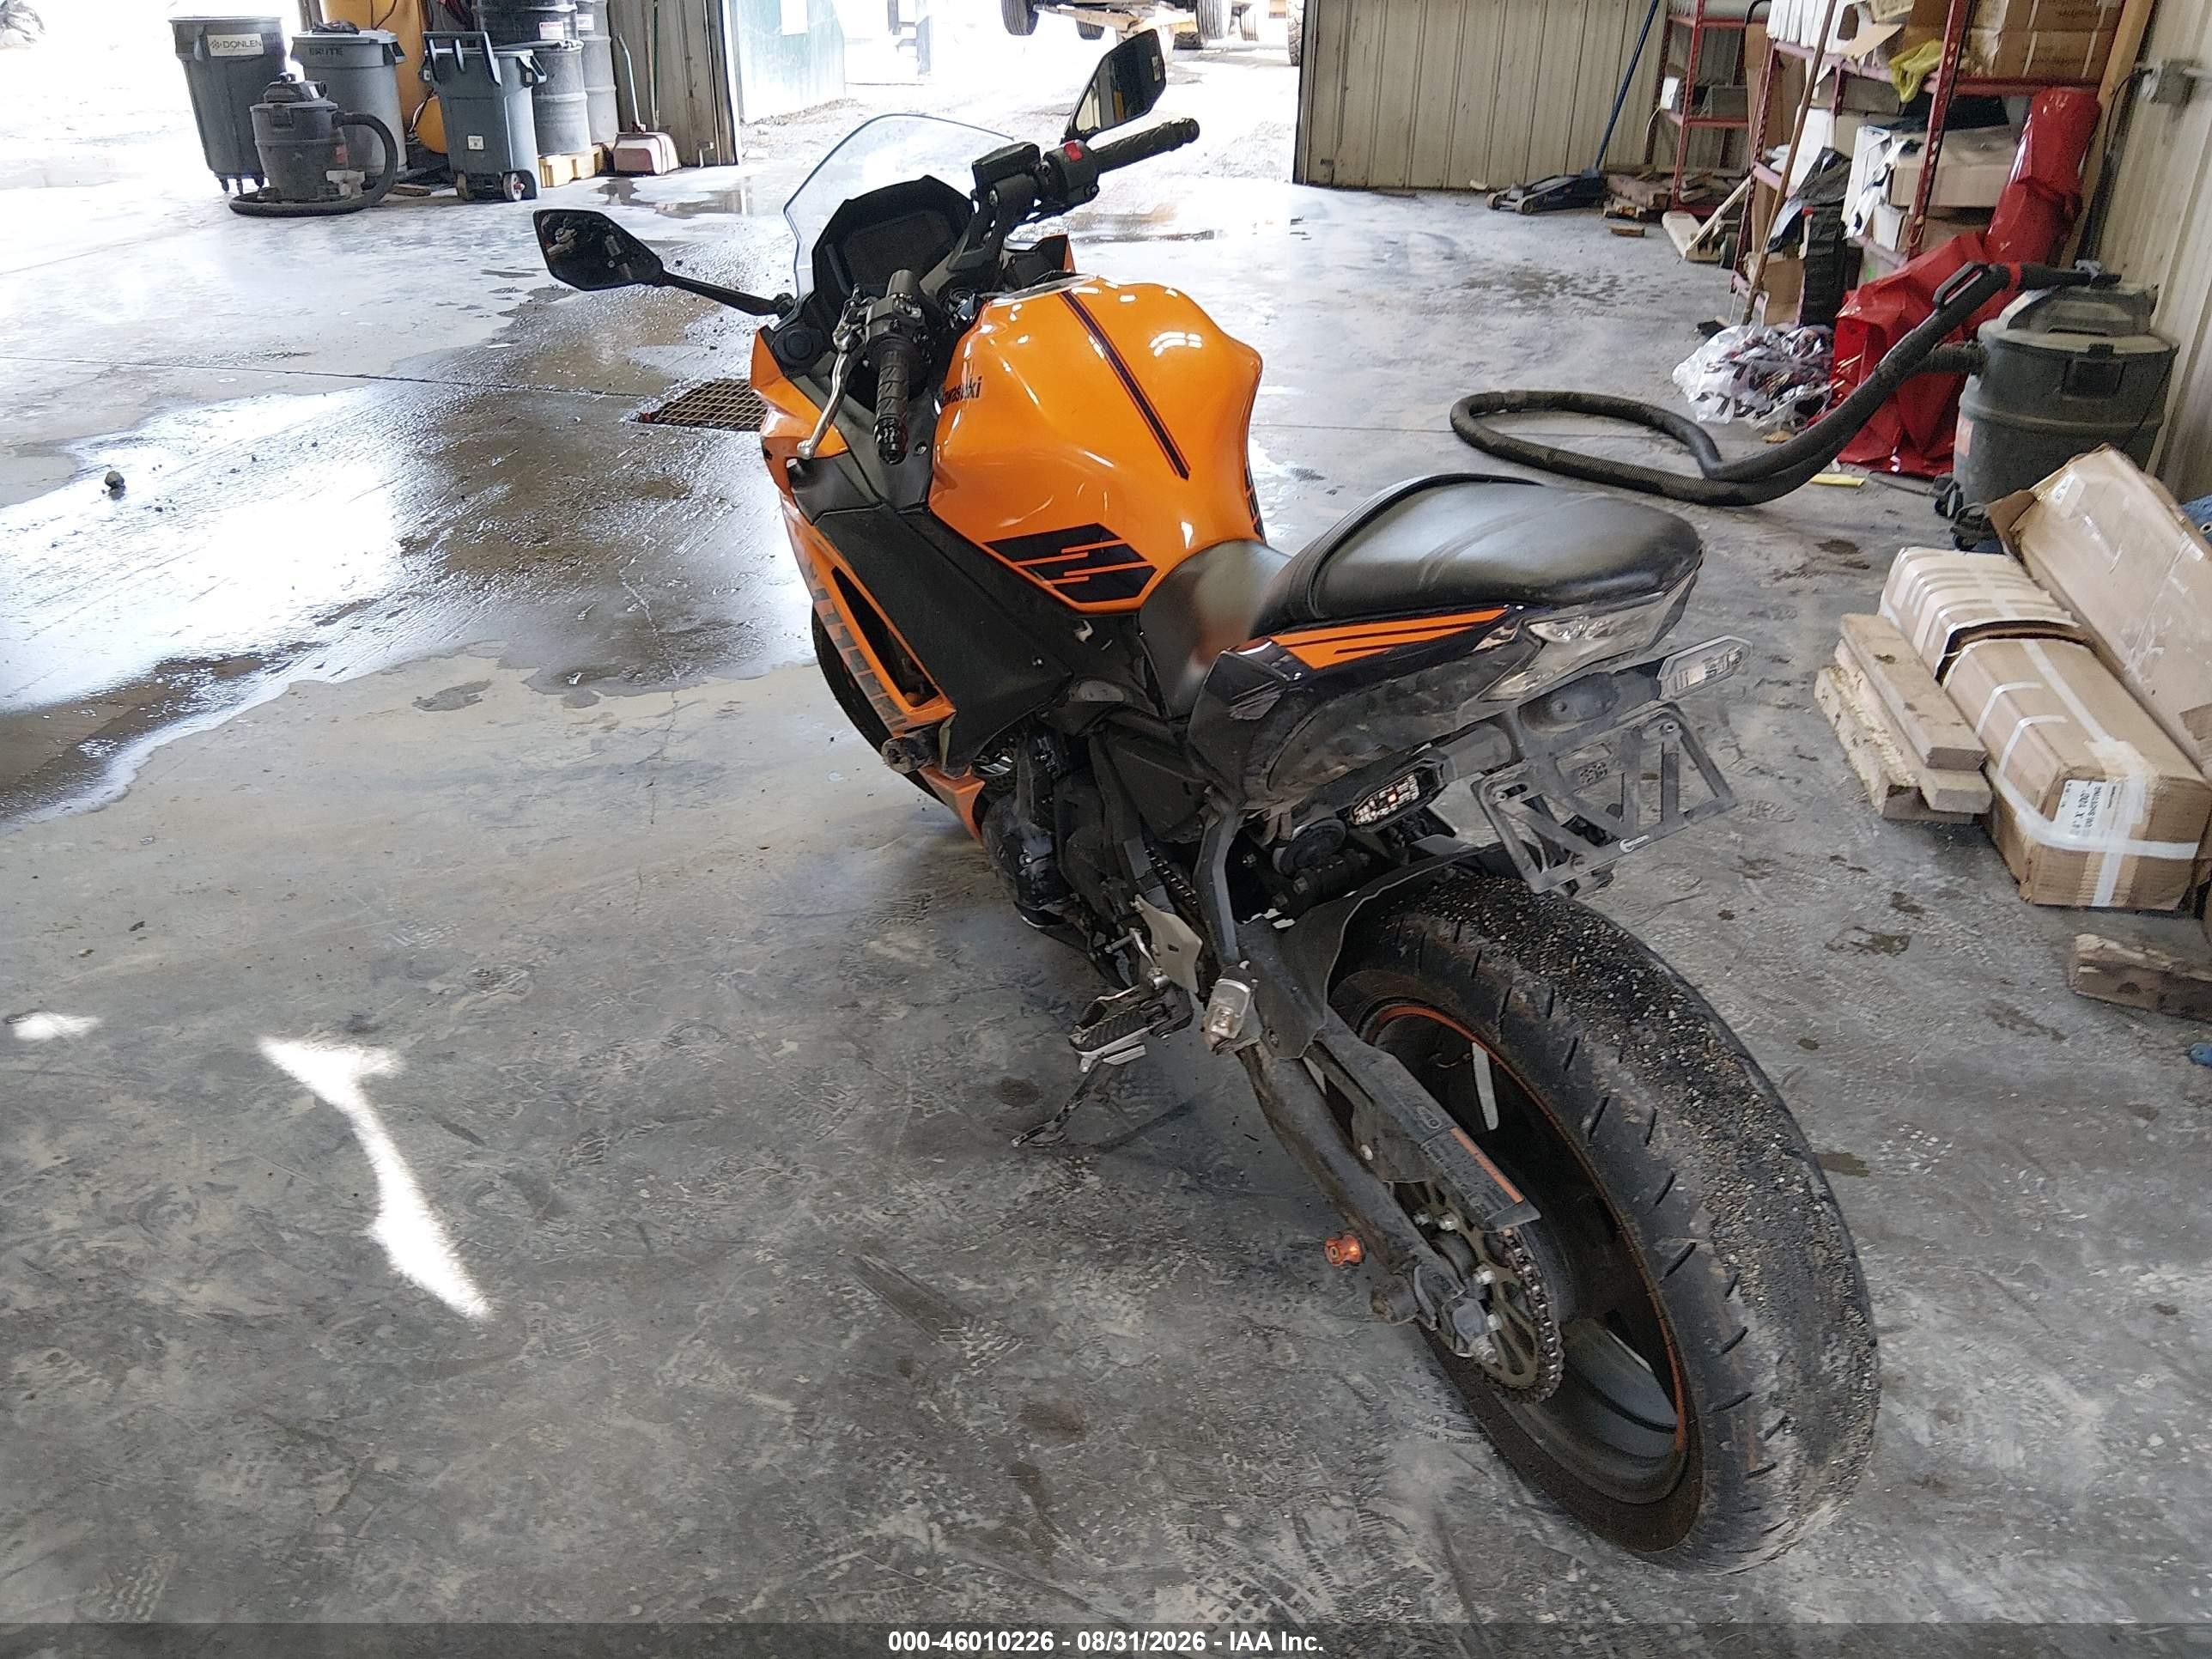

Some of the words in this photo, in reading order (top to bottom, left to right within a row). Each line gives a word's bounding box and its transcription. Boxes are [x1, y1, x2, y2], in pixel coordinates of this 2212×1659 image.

[222, 40, 263, 49] DONLEN
[309, 46, 343, 56] BRUTE
[942, 375, 983, 408] wasaki
